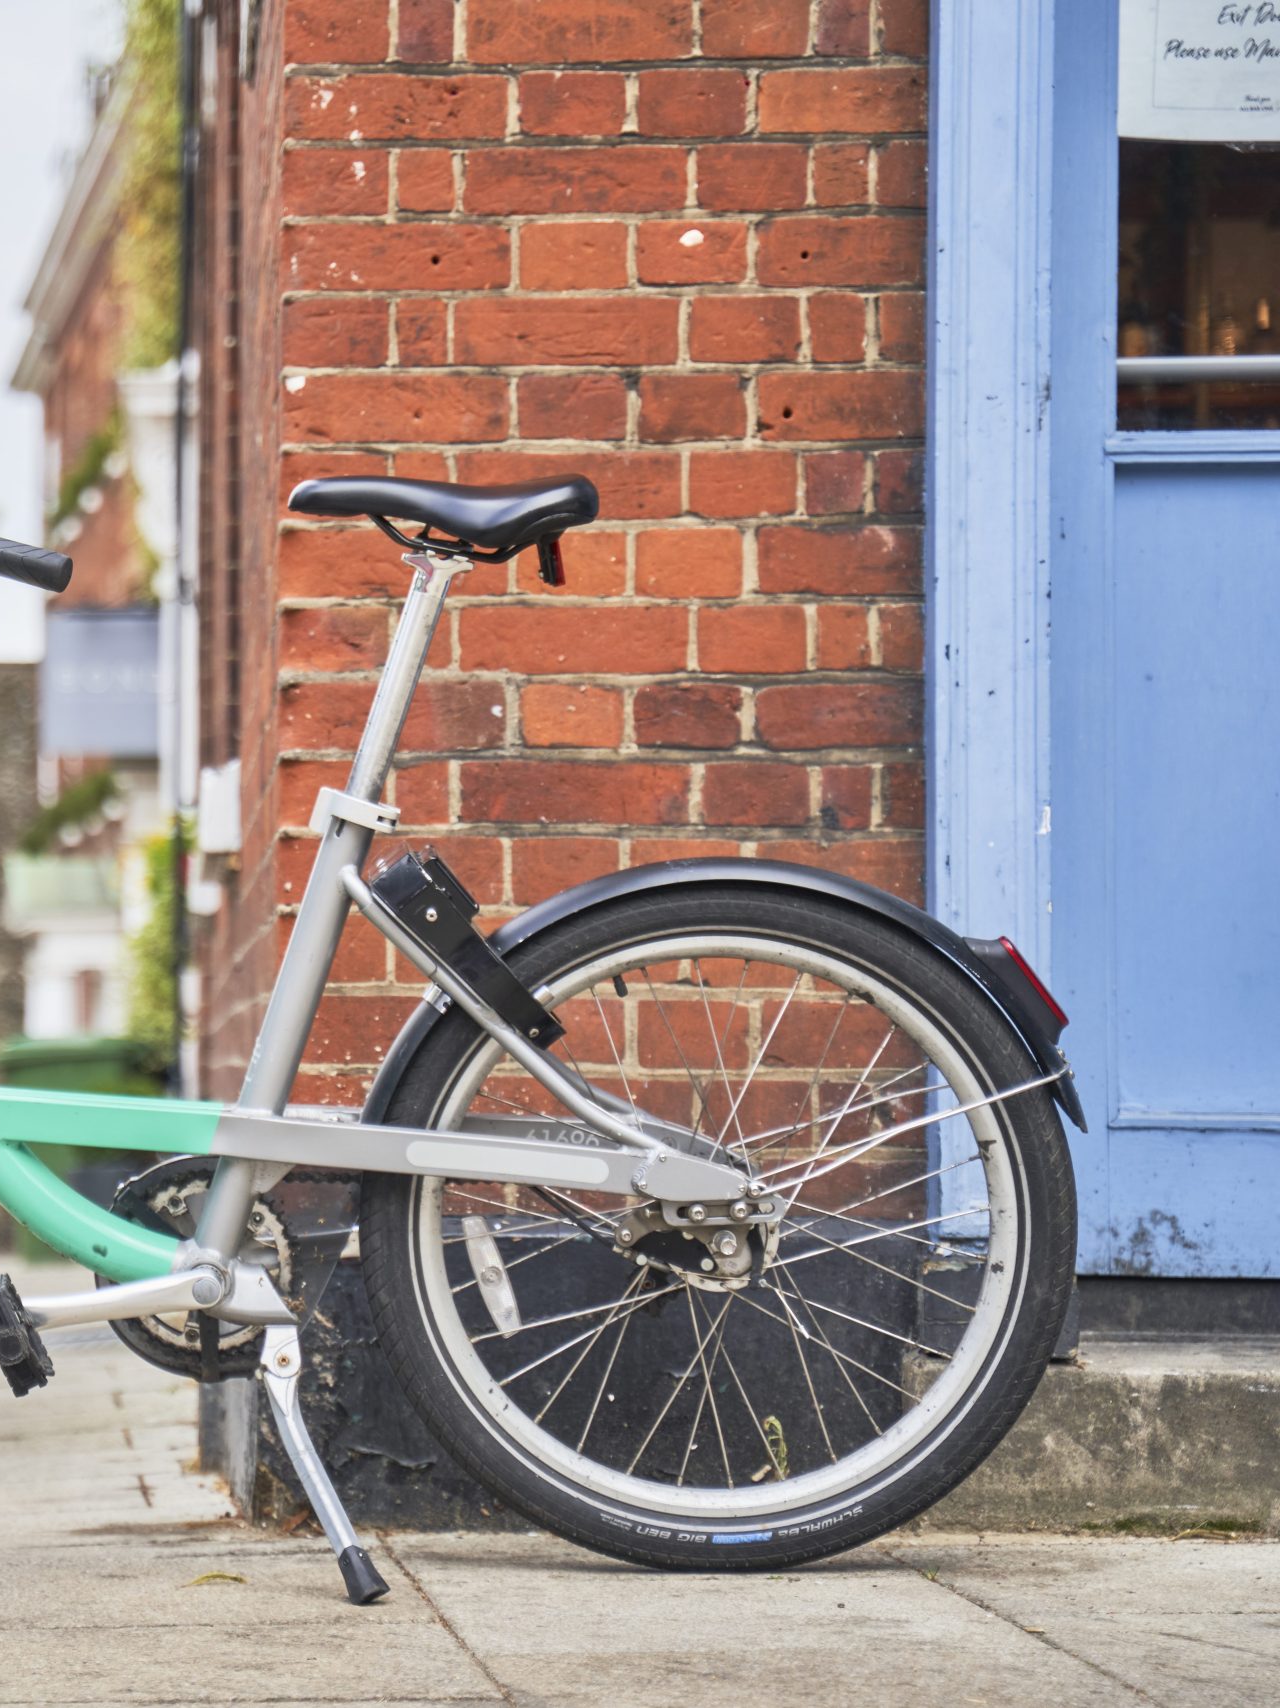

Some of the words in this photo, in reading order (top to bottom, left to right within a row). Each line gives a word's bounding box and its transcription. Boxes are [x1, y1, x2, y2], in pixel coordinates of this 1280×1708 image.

[1217, 3, 1252, 26] Exit
[1163, 38, 1211, 61] Please
[1214, 46, 1240, 61] use
[636, 1525, 672, 1540] BEN
[778, 1505, 863, 1537] SCHWALBE
[677, 1533, 707, 1544] BIG
